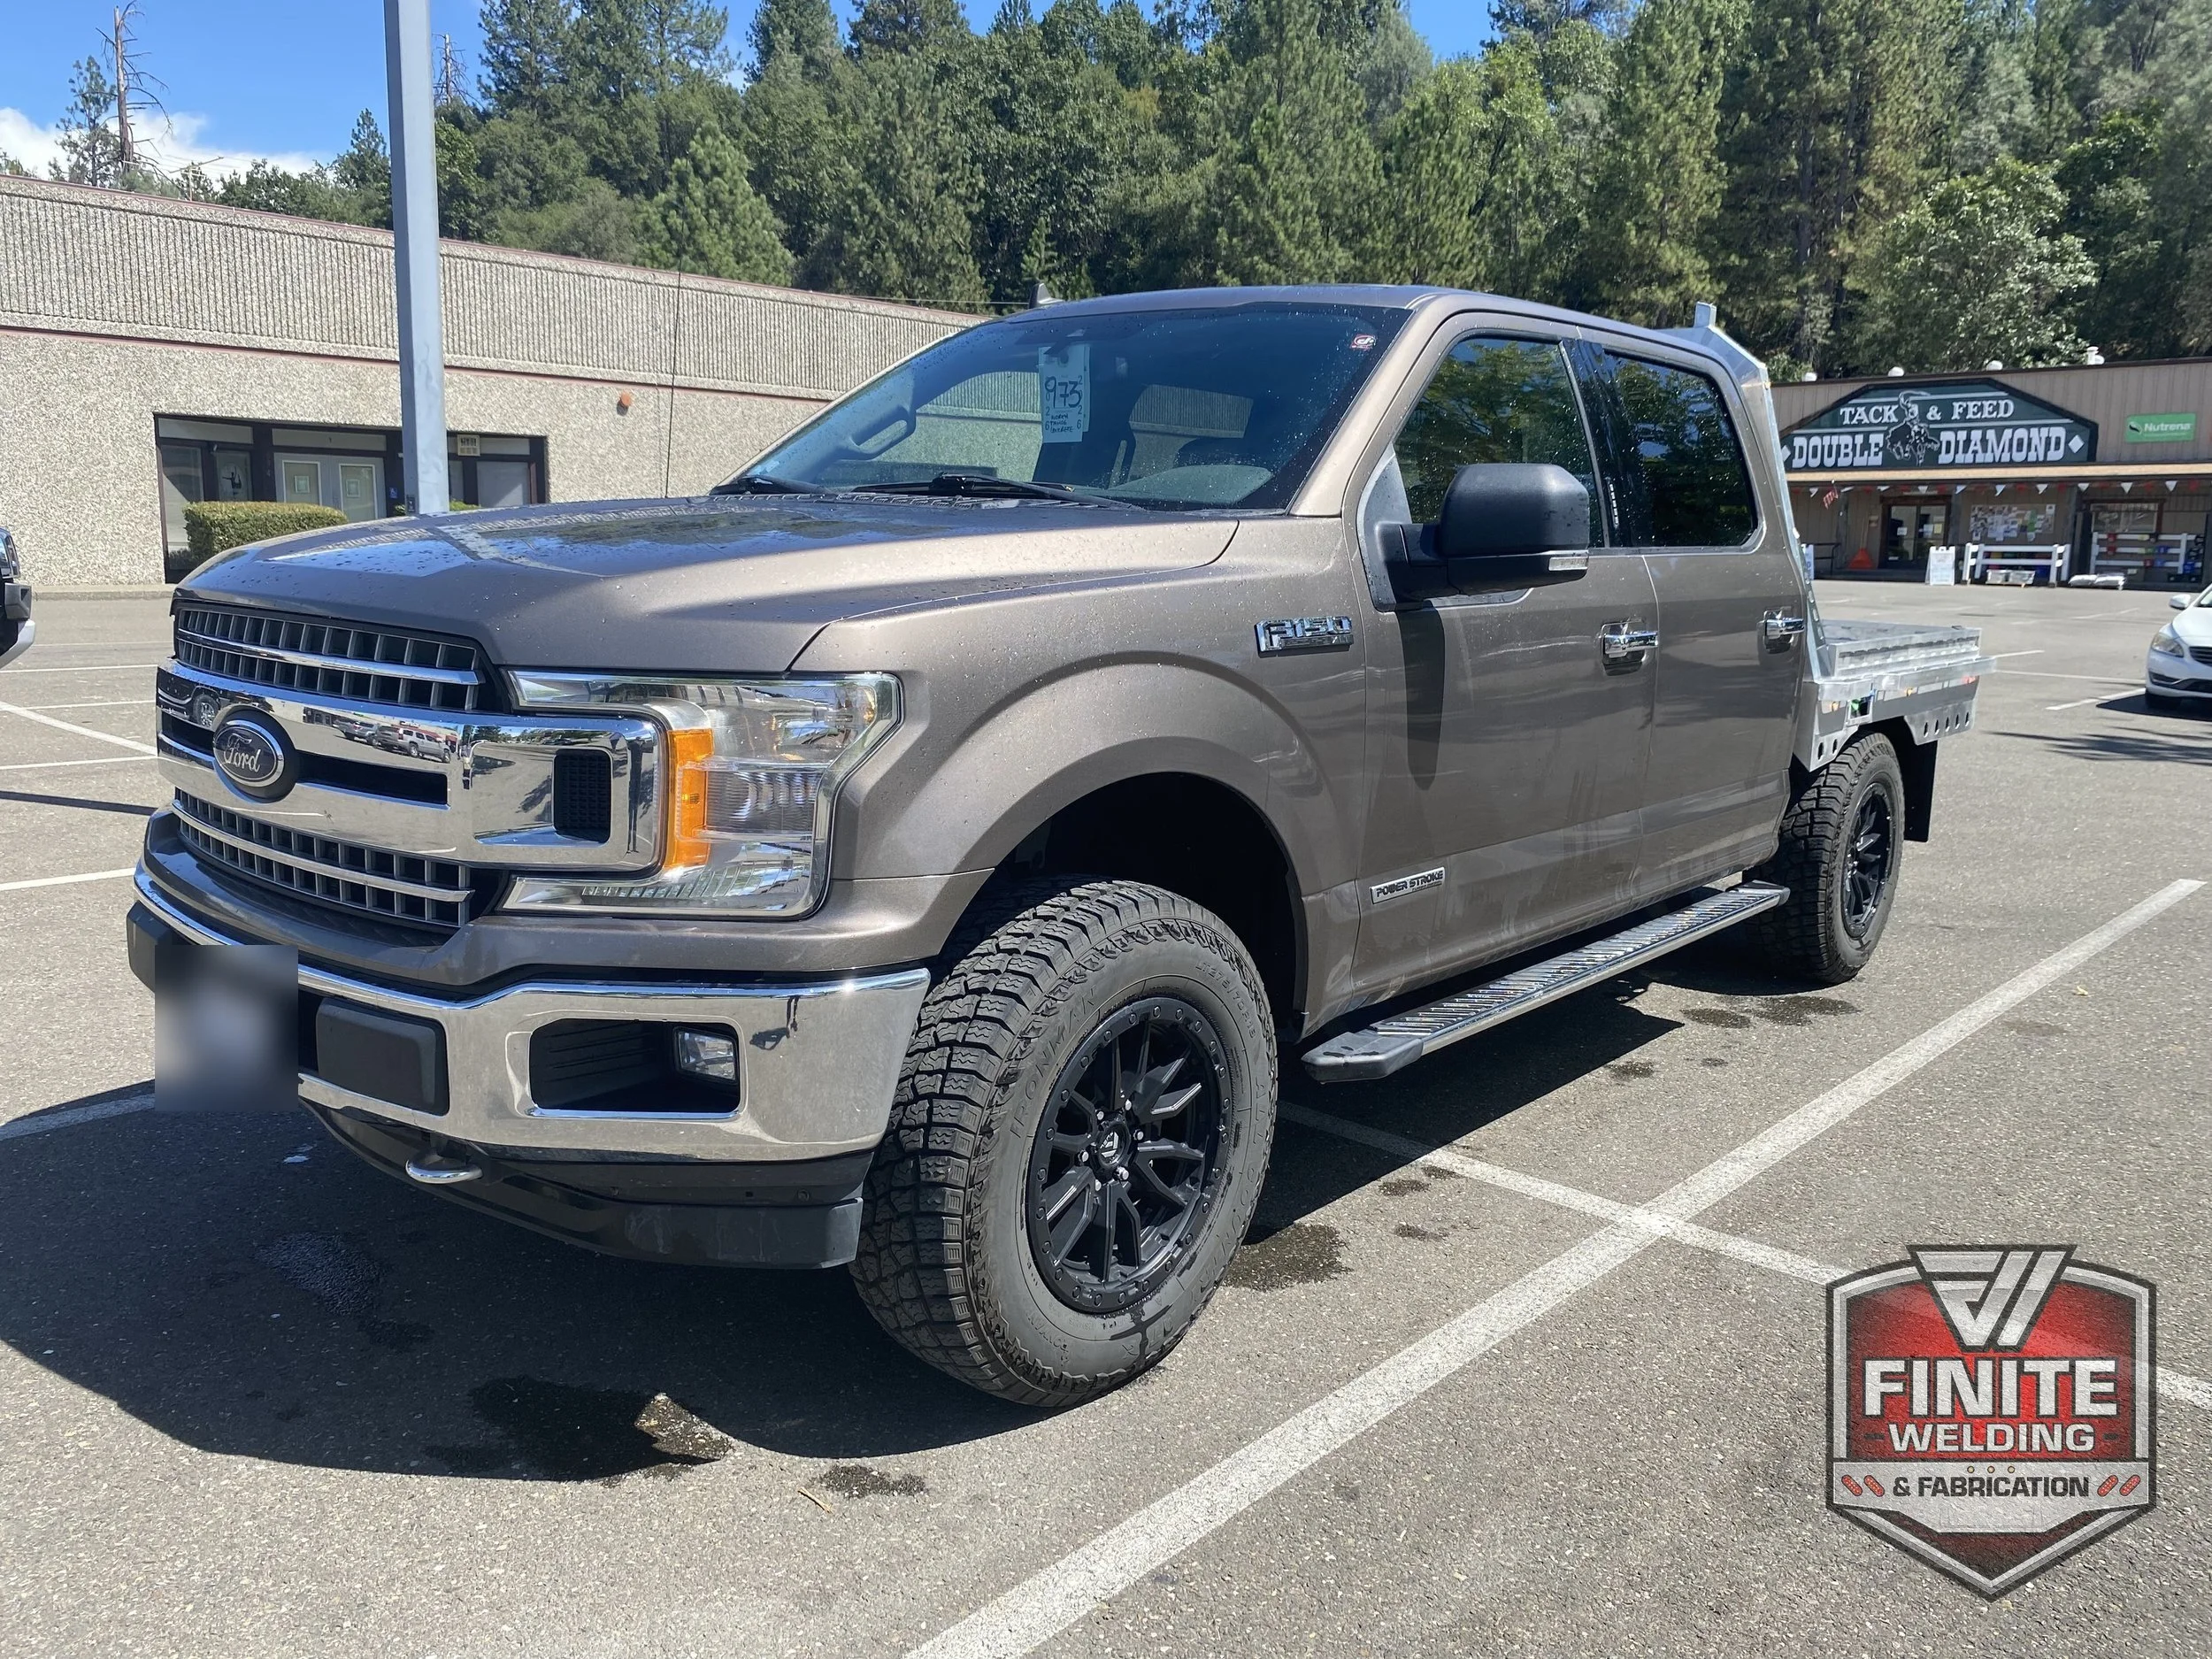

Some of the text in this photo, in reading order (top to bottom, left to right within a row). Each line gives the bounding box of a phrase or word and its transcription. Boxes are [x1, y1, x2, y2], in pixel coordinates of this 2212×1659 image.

[1044, 376, 1082, 408] 973
[1839, 399, 2015, 425] TACK & FEED
[2144, 423, 2192, 432] Nutrena
[1792, 426, 2067, 468] DOUBLE DIAMOND
[222, 733, 261, 772] Ford
[1376, 881, 1408, 897] POWER
[1409, 871, 1443, 887] STROKE
